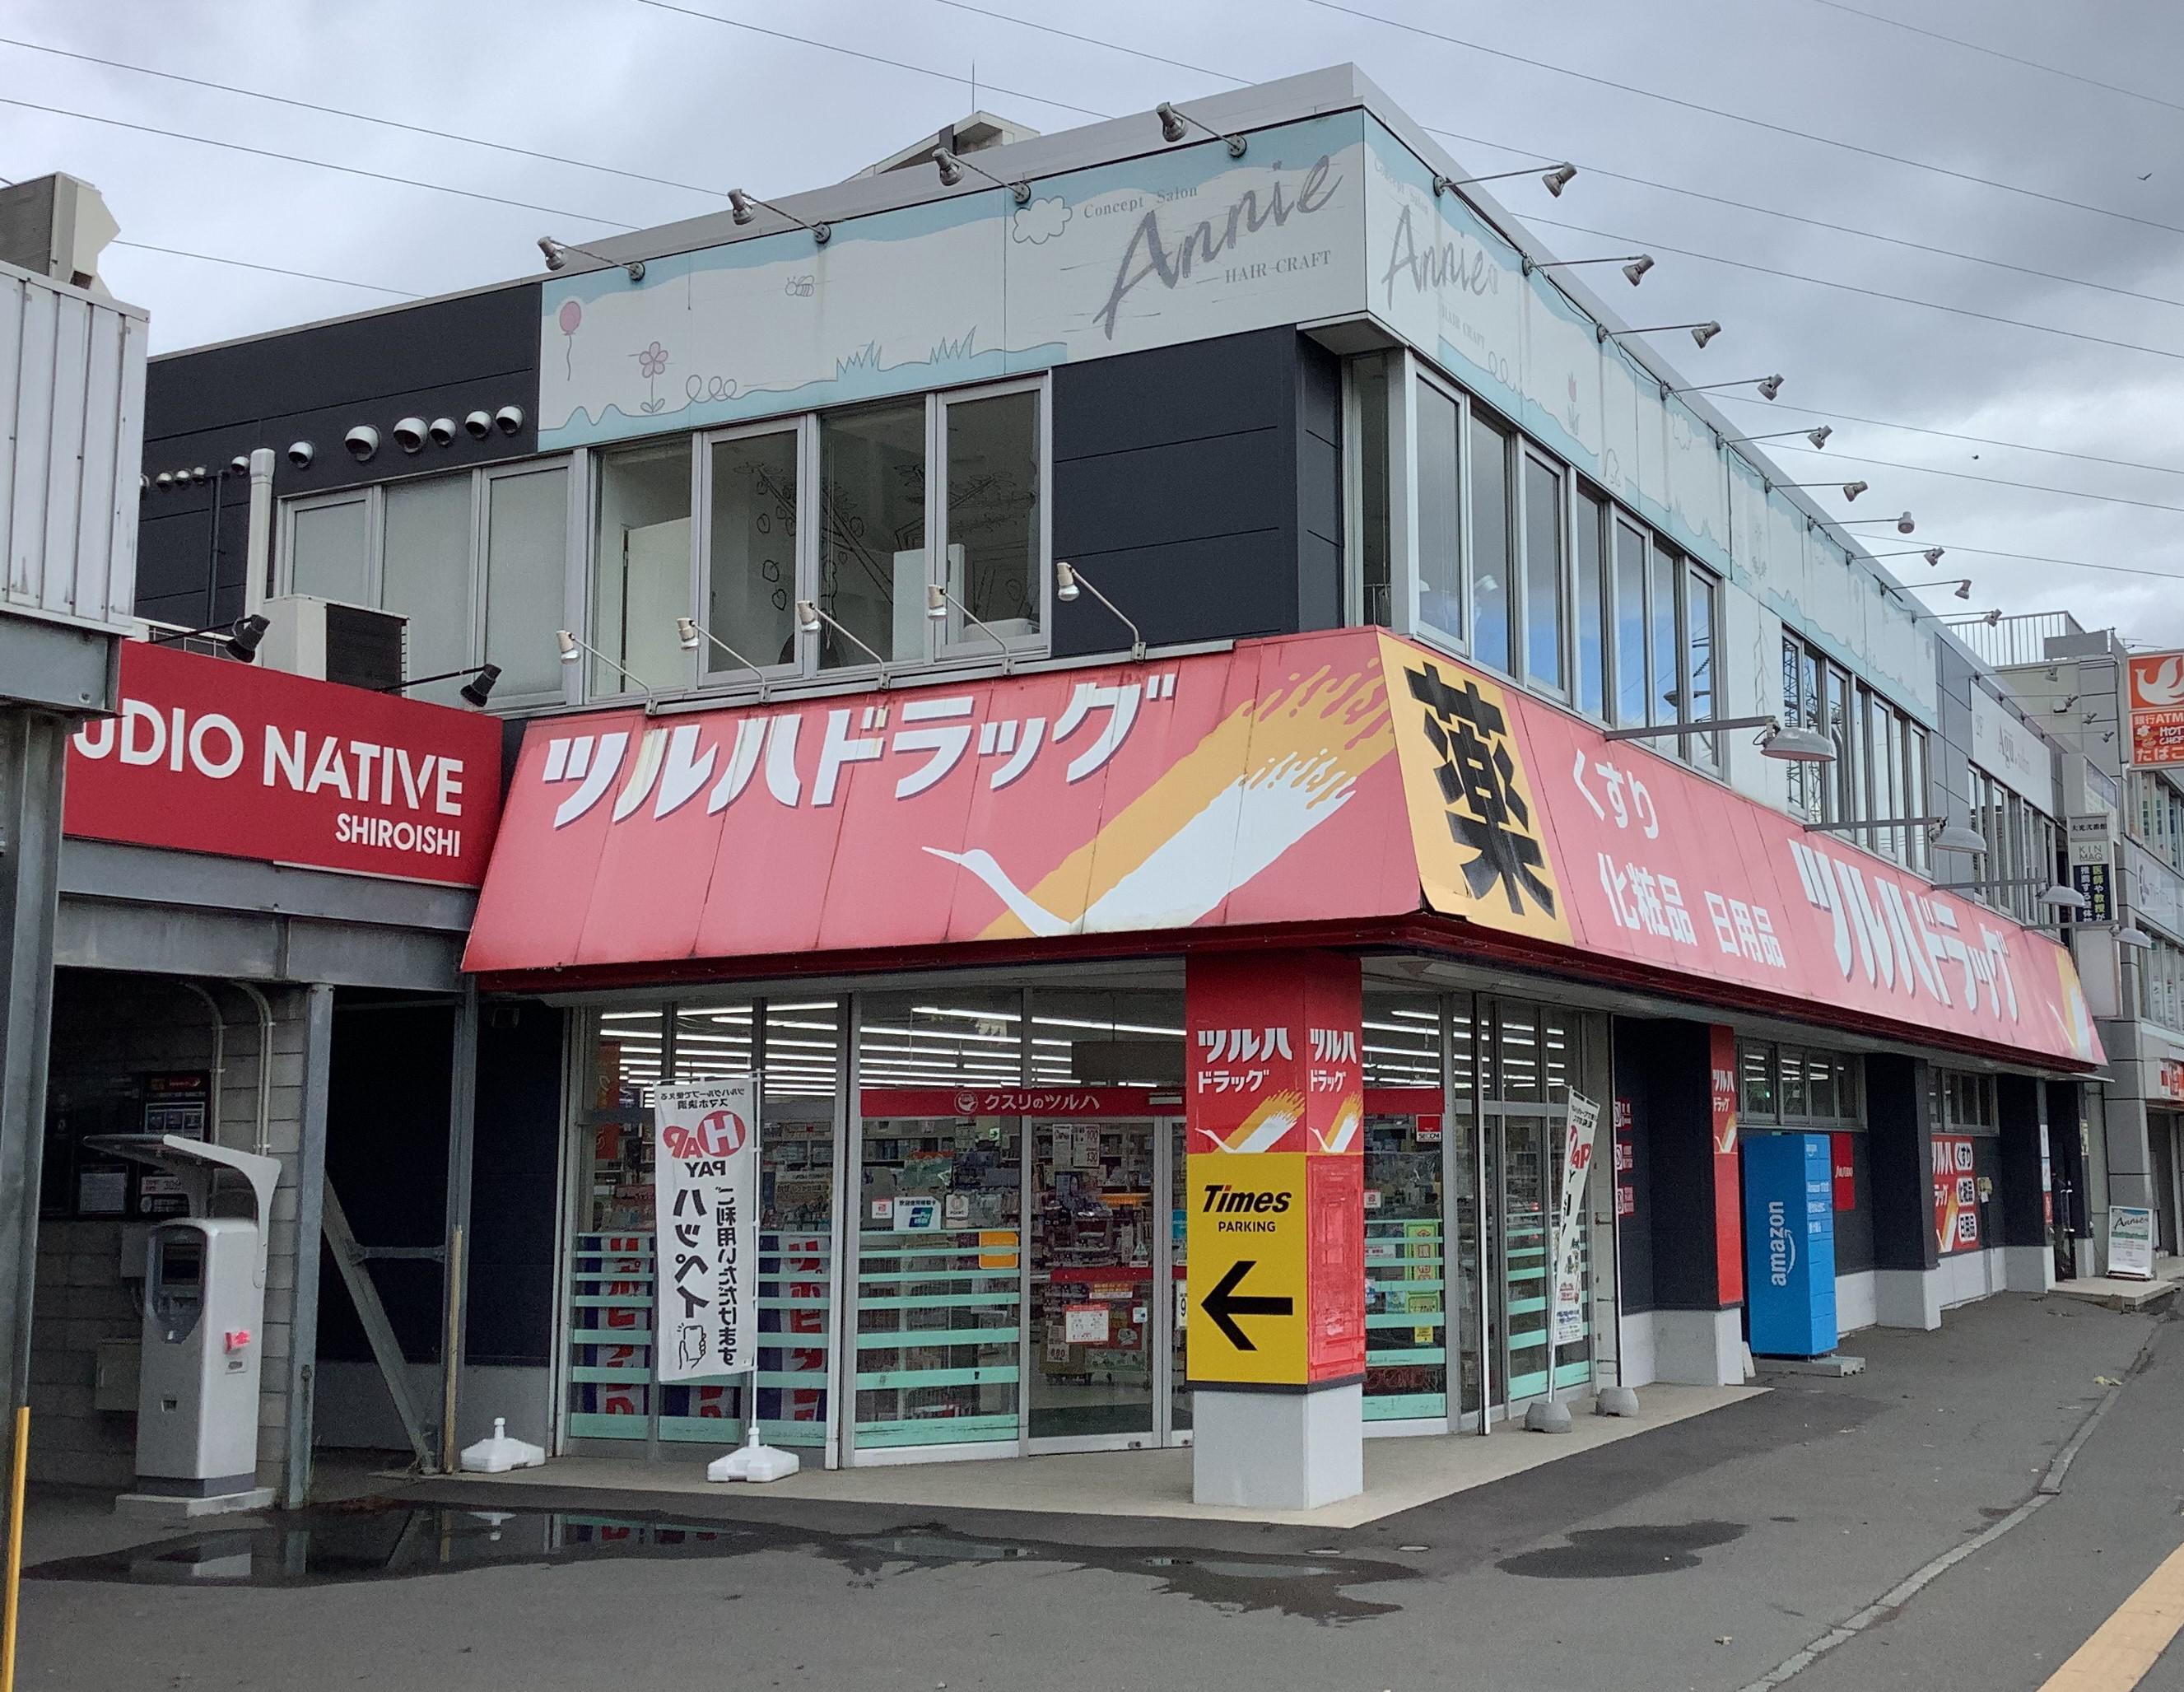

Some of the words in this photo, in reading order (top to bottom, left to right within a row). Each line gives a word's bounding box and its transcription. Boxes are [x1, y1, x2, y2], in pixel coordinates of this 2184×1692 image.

[1083, 195, 1144, 218] Concept
[1156, 185, 1198, 205] Salon
[1092, 154, 1347, 341] Annie
[1225, 261, 1267, 284] HAIR
[1275, 249, 1331, 273] CRAFT
[542, 673, 1176, 828] ツルハドラッグ
[263, 725, 463, 816] NATIVE
[1404, 661, 1556, 920] 薬
[1572, 748, 1659, 840] くすり
[335, 813, 460, 858] SHIROISHI
[1598, 852, 1697, 946] 化粧品
[1707, 892, 1786, 968] 日用品
[1788, 838, 2019, 1024] ツルハドラッグ
[1197, 1028, 1293, 1063] ツルハ
[1310, 1028, 1357, 1064] ツルハ
[1197, 1070, 1269, 1093] ドラッグ
[1310, 1070, 1346, 1093] ドラッグ
[1712, 1069, 1735, 1093] ツルハ
[985, 1093, 1100, 1111] クスリのツルハ
[1957, 1145, 1971, 1168] くすり
[1202, 1185, 1292, 1214] Times
[1218, 1221, 1276, 1233] PARKING
[1768, 1200, 1785, 1287] amazon
